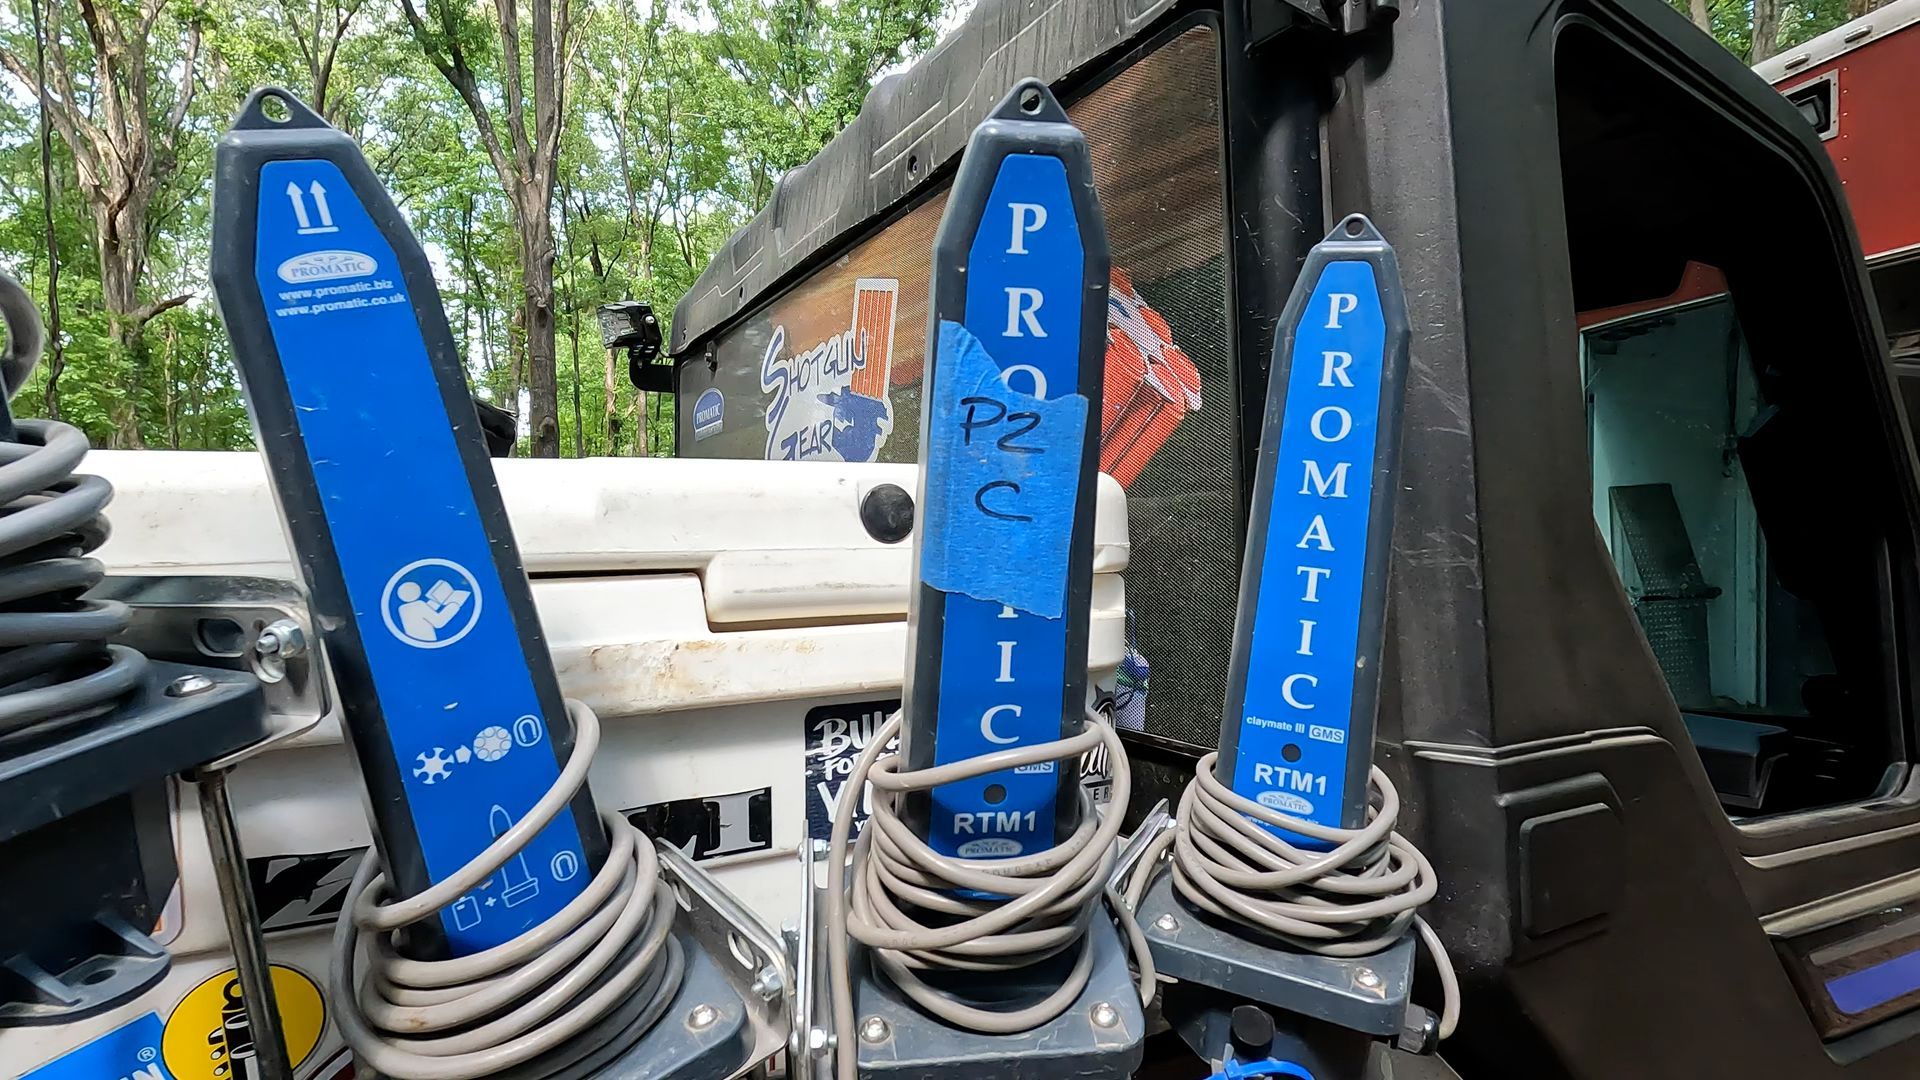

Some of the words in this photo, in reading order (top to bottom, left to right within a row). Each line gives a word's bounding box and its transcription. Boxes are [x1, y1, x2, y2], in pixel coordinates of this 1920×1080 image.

[291, 261, 367, 278] PROMATIC
[278, 279, 394, 300] www.promatic.biz
[275, 293, 406, 317] www.promatic.co.uk
[763, 330, 867, 424] SHOTGUN
[960, 396, 1045, 454] P2
[975, 480, 1033, 522] C
[1282, 293, 1359, 709] PROMATIC
[1246, 715, 1293, 732] claymate
[1311, 727, 1343, 742] GMS
[1254, 762, 1327, 796] RTM1
[1263, 796, 1308, 812] PROMATIC
[953, 810, 1036, 835] RTM1
